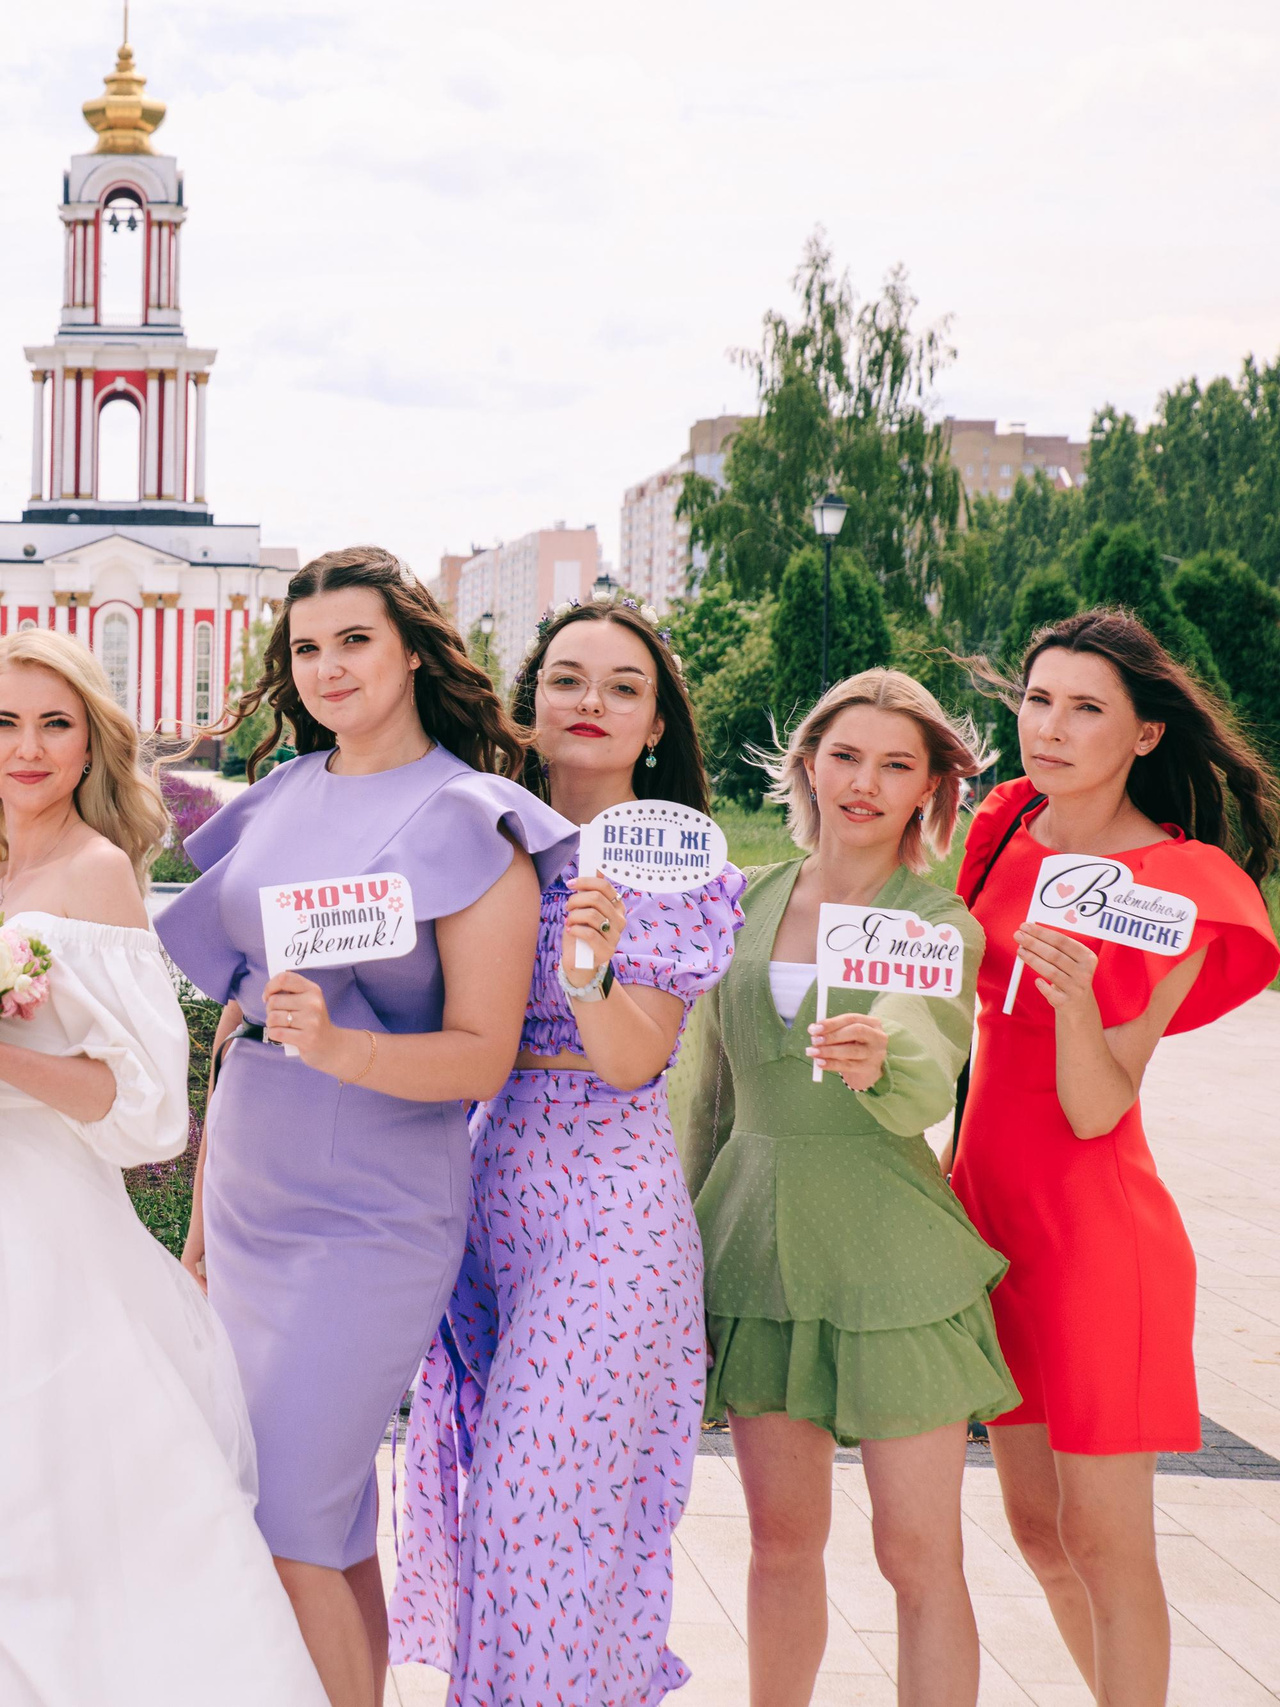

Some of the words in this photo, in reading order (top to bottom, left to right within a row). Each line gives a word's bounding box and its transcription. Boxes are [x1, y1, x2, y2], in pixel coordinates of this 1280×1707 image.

[603, 824, 666, 847] ВЕЗЕТ
[680, 830, 711, 851] ЖЕ
[292, 879, 389, 911] ХОЧУ
[1040, 863, 1121, 917] В
[1113, 890, 1189, 920] активном
[310, 906, 386, 929] ПОЙМАТЬ
[1098, 911, 1184, 949] ПОИСКЕ
[284, 916, 403, 966] букетик!
[826, 912, 901, 954] Я
[889, 938, 960, 962] тоже
[842, 957, 953, 992] ХОЧУ!
